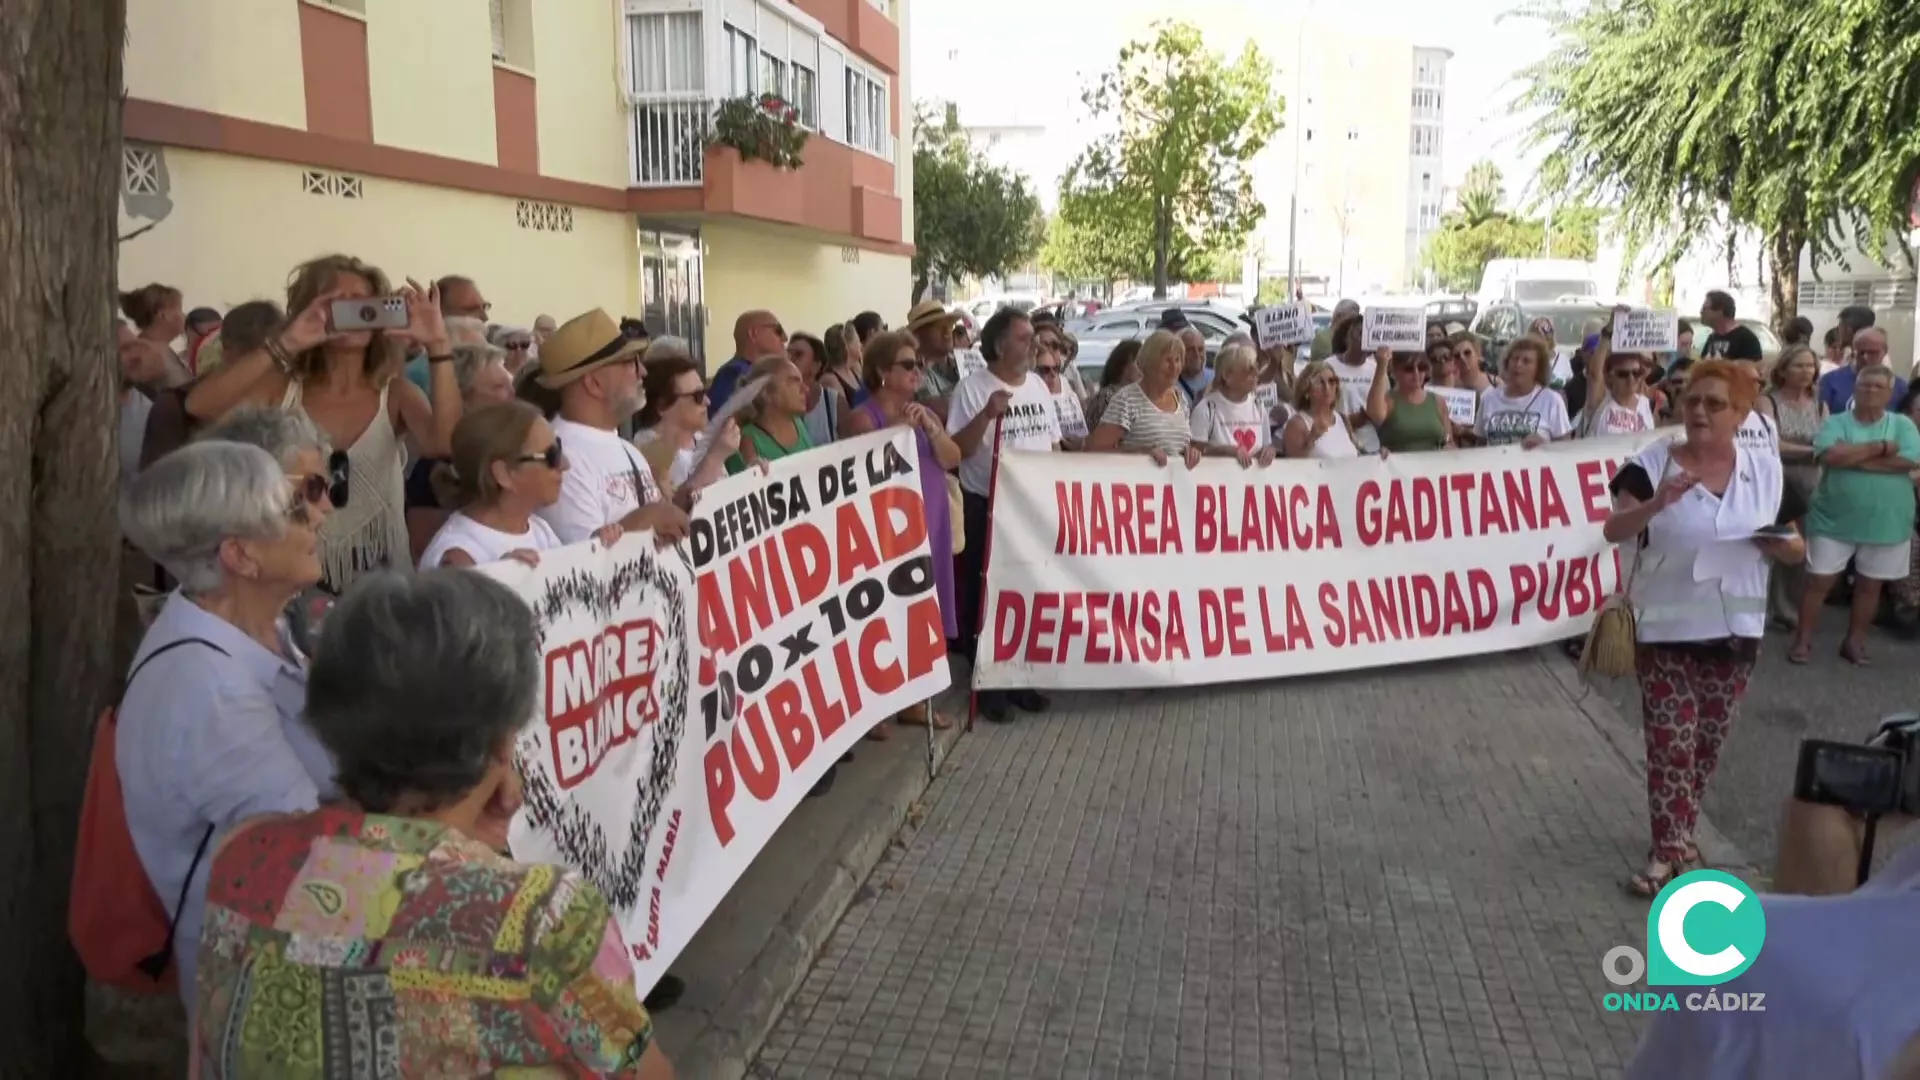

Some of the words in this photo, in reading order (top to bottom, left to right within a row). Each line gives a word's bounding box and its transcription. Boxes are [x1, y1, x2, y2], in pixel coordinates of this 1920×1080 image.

[689, 475, 811, 568] DEFENSA
[818, 455, 858, 507] DE
[865, 441, 913, 487] LA
[1055, 481, 1183, 556] MAREA
[1195, 483, 1342, 553] BLANCA
[1355, 466, 1571, 547] GADITANA
[818, 555, 936, 638] 100
[993, 589, 1190, 664] DEFENSA
[1199, 586, 1252, 659] DE
[1258, 584, 1314, 653] LA
[1318, 568, 1498, 648] SANIDAD
[704, 596, 948, 848] PÚBLICA
[647, 886, 661, 950] SANTA
[656, 808, 682, 882] MARÍA
